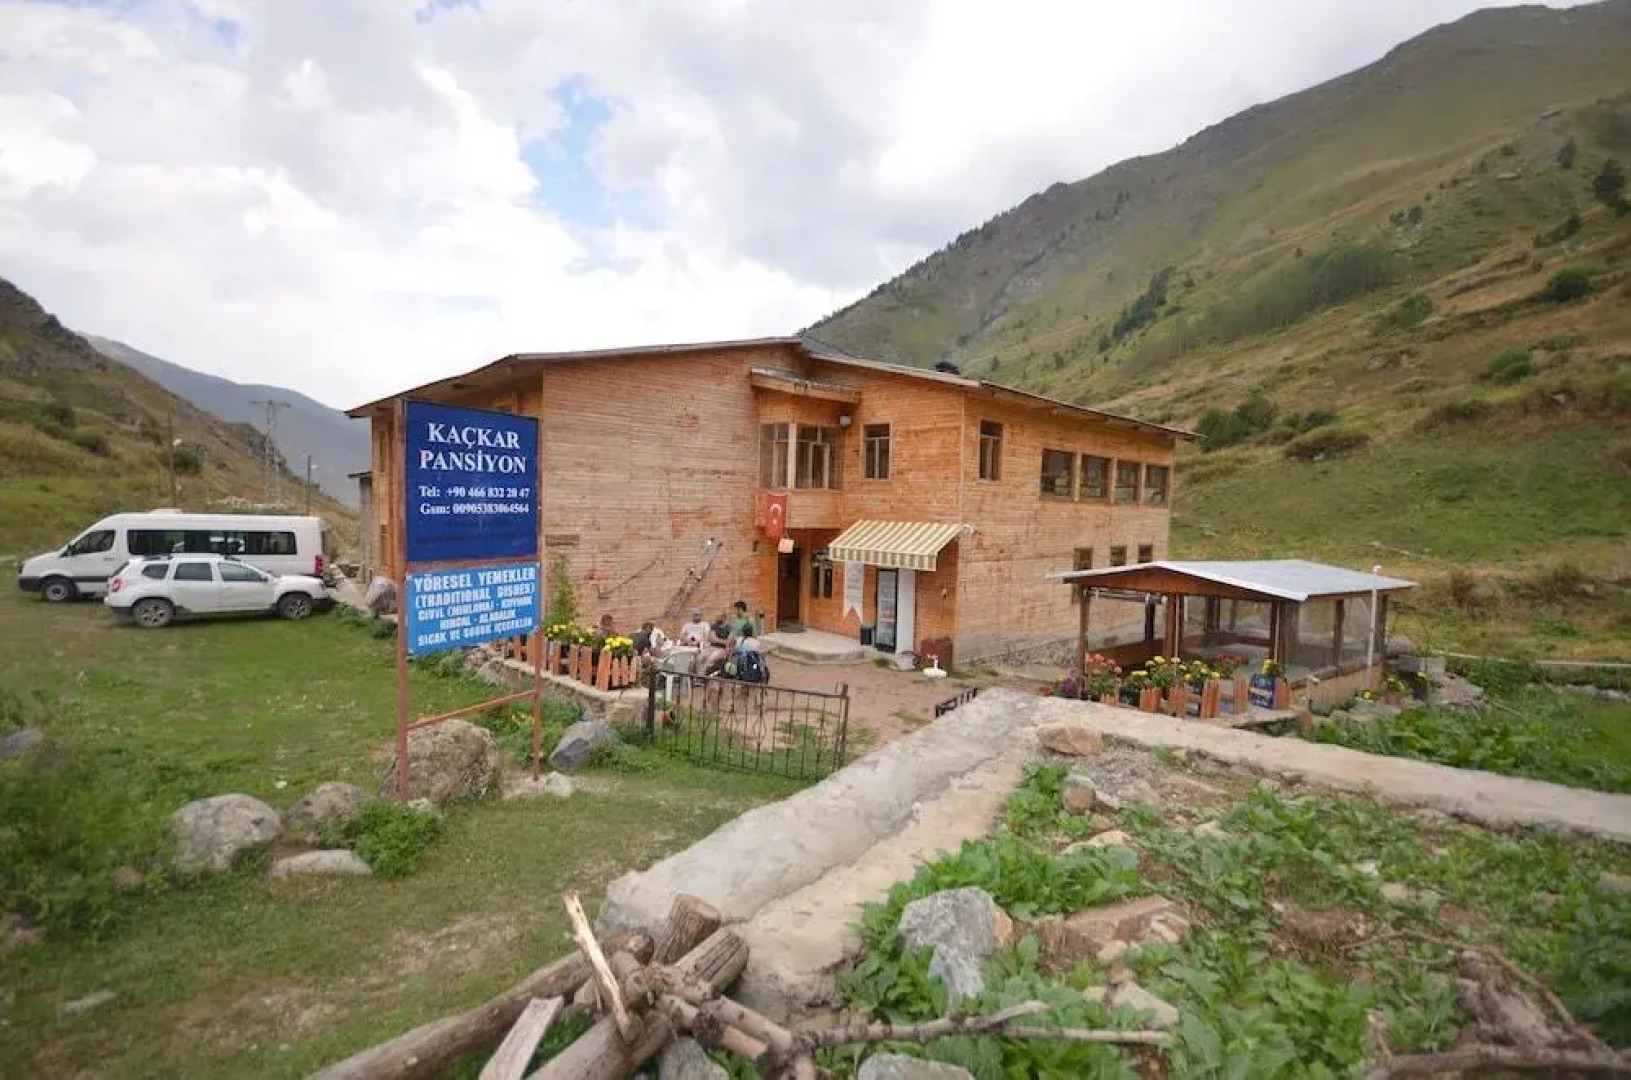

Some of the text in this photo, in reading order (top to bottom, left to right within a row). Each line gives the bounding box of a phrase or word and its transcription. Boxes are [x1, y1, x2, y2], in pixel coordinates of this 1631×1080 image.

[427, 422, 521, 449] KAÇKAR
[419, 449, 527, 474] PANSİYON
[419, 485, 441, 498] Tel:
[446, 486, 466, 498] +90
[467, 487, 486, 498] 466
[487, 487, 505, 498] 832
[519, 488, 530, 498] 47
[420, 503, 450, 515] Gsm:
[414, 567, 536, 592] YÖRESEL YEMEKLER
